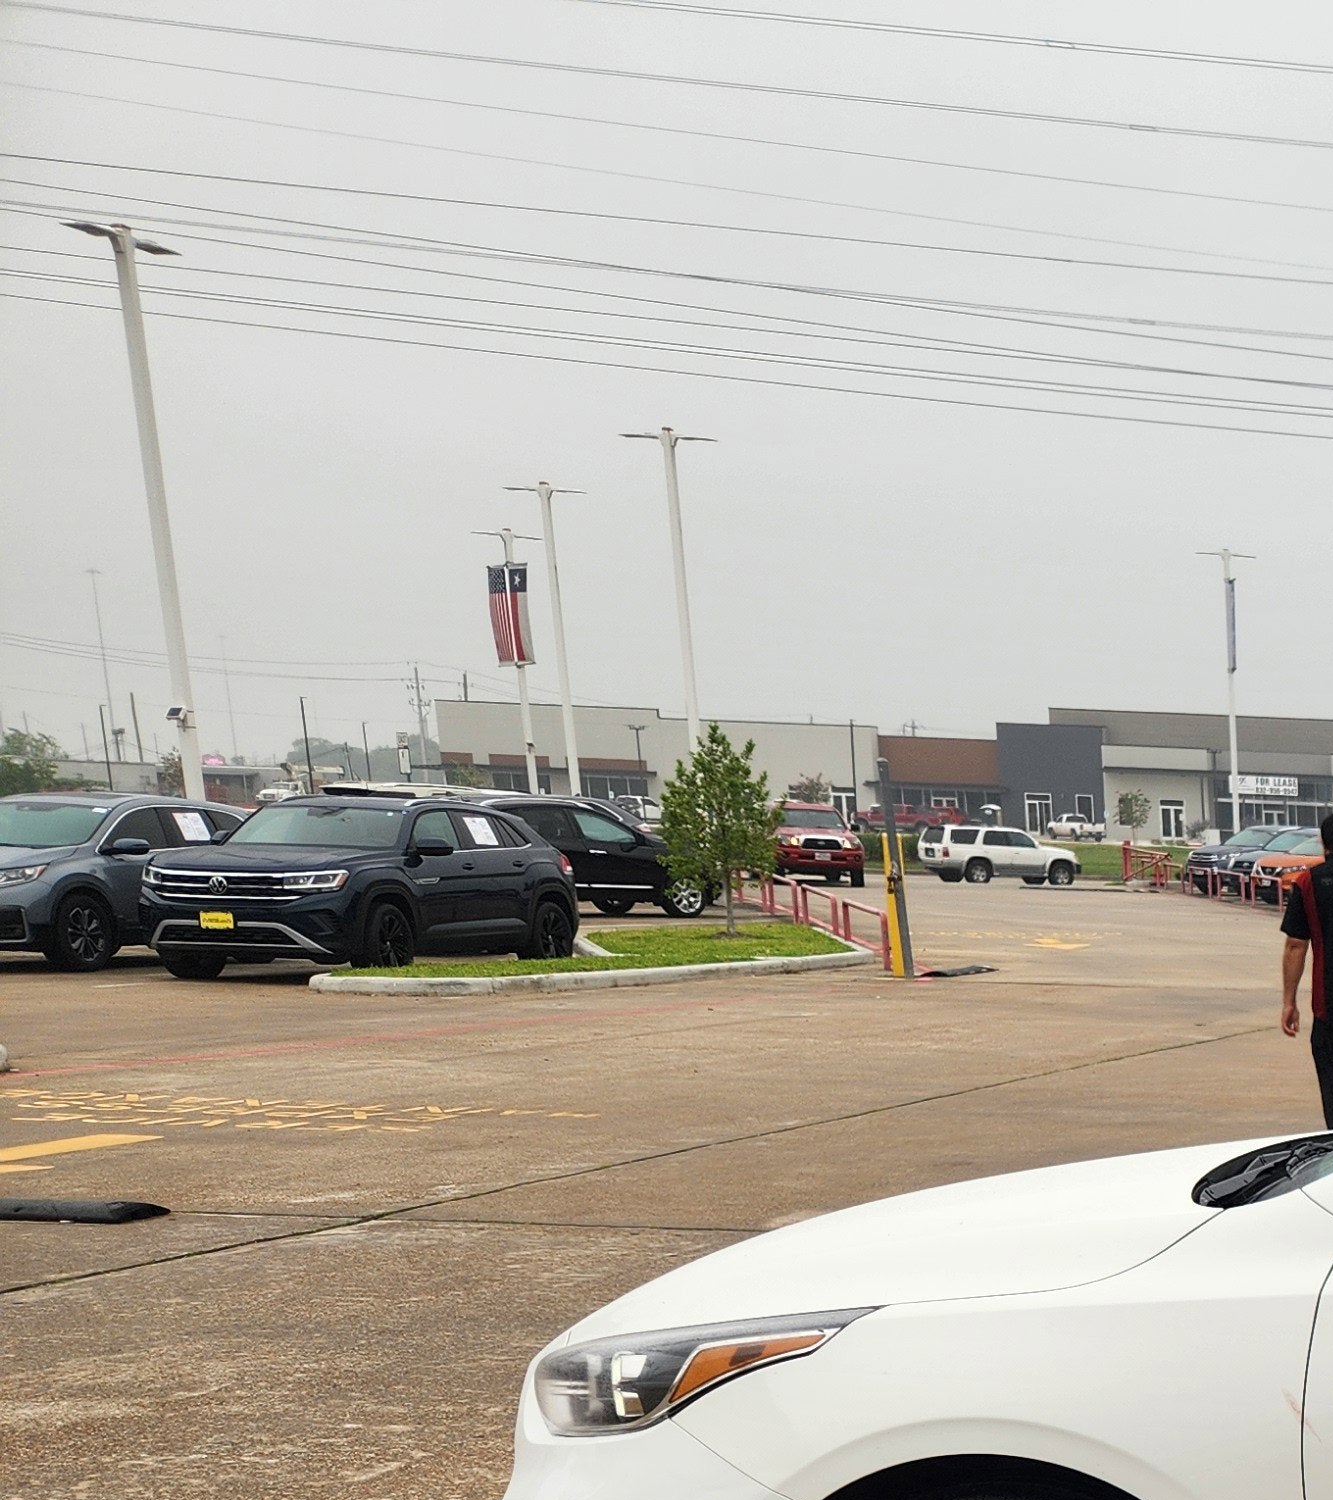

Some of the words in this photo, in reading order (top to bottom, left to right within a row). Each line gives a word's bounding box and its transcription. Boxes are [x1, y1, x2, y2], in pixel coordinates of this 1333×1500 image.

[1256, 777, 1270, 786] FOR
[1273, 778, 1297, 787] LEASE
[18, 1100, 461, 1122] EXPRESS
[11, 1112, 432, 1132] SERVICE
